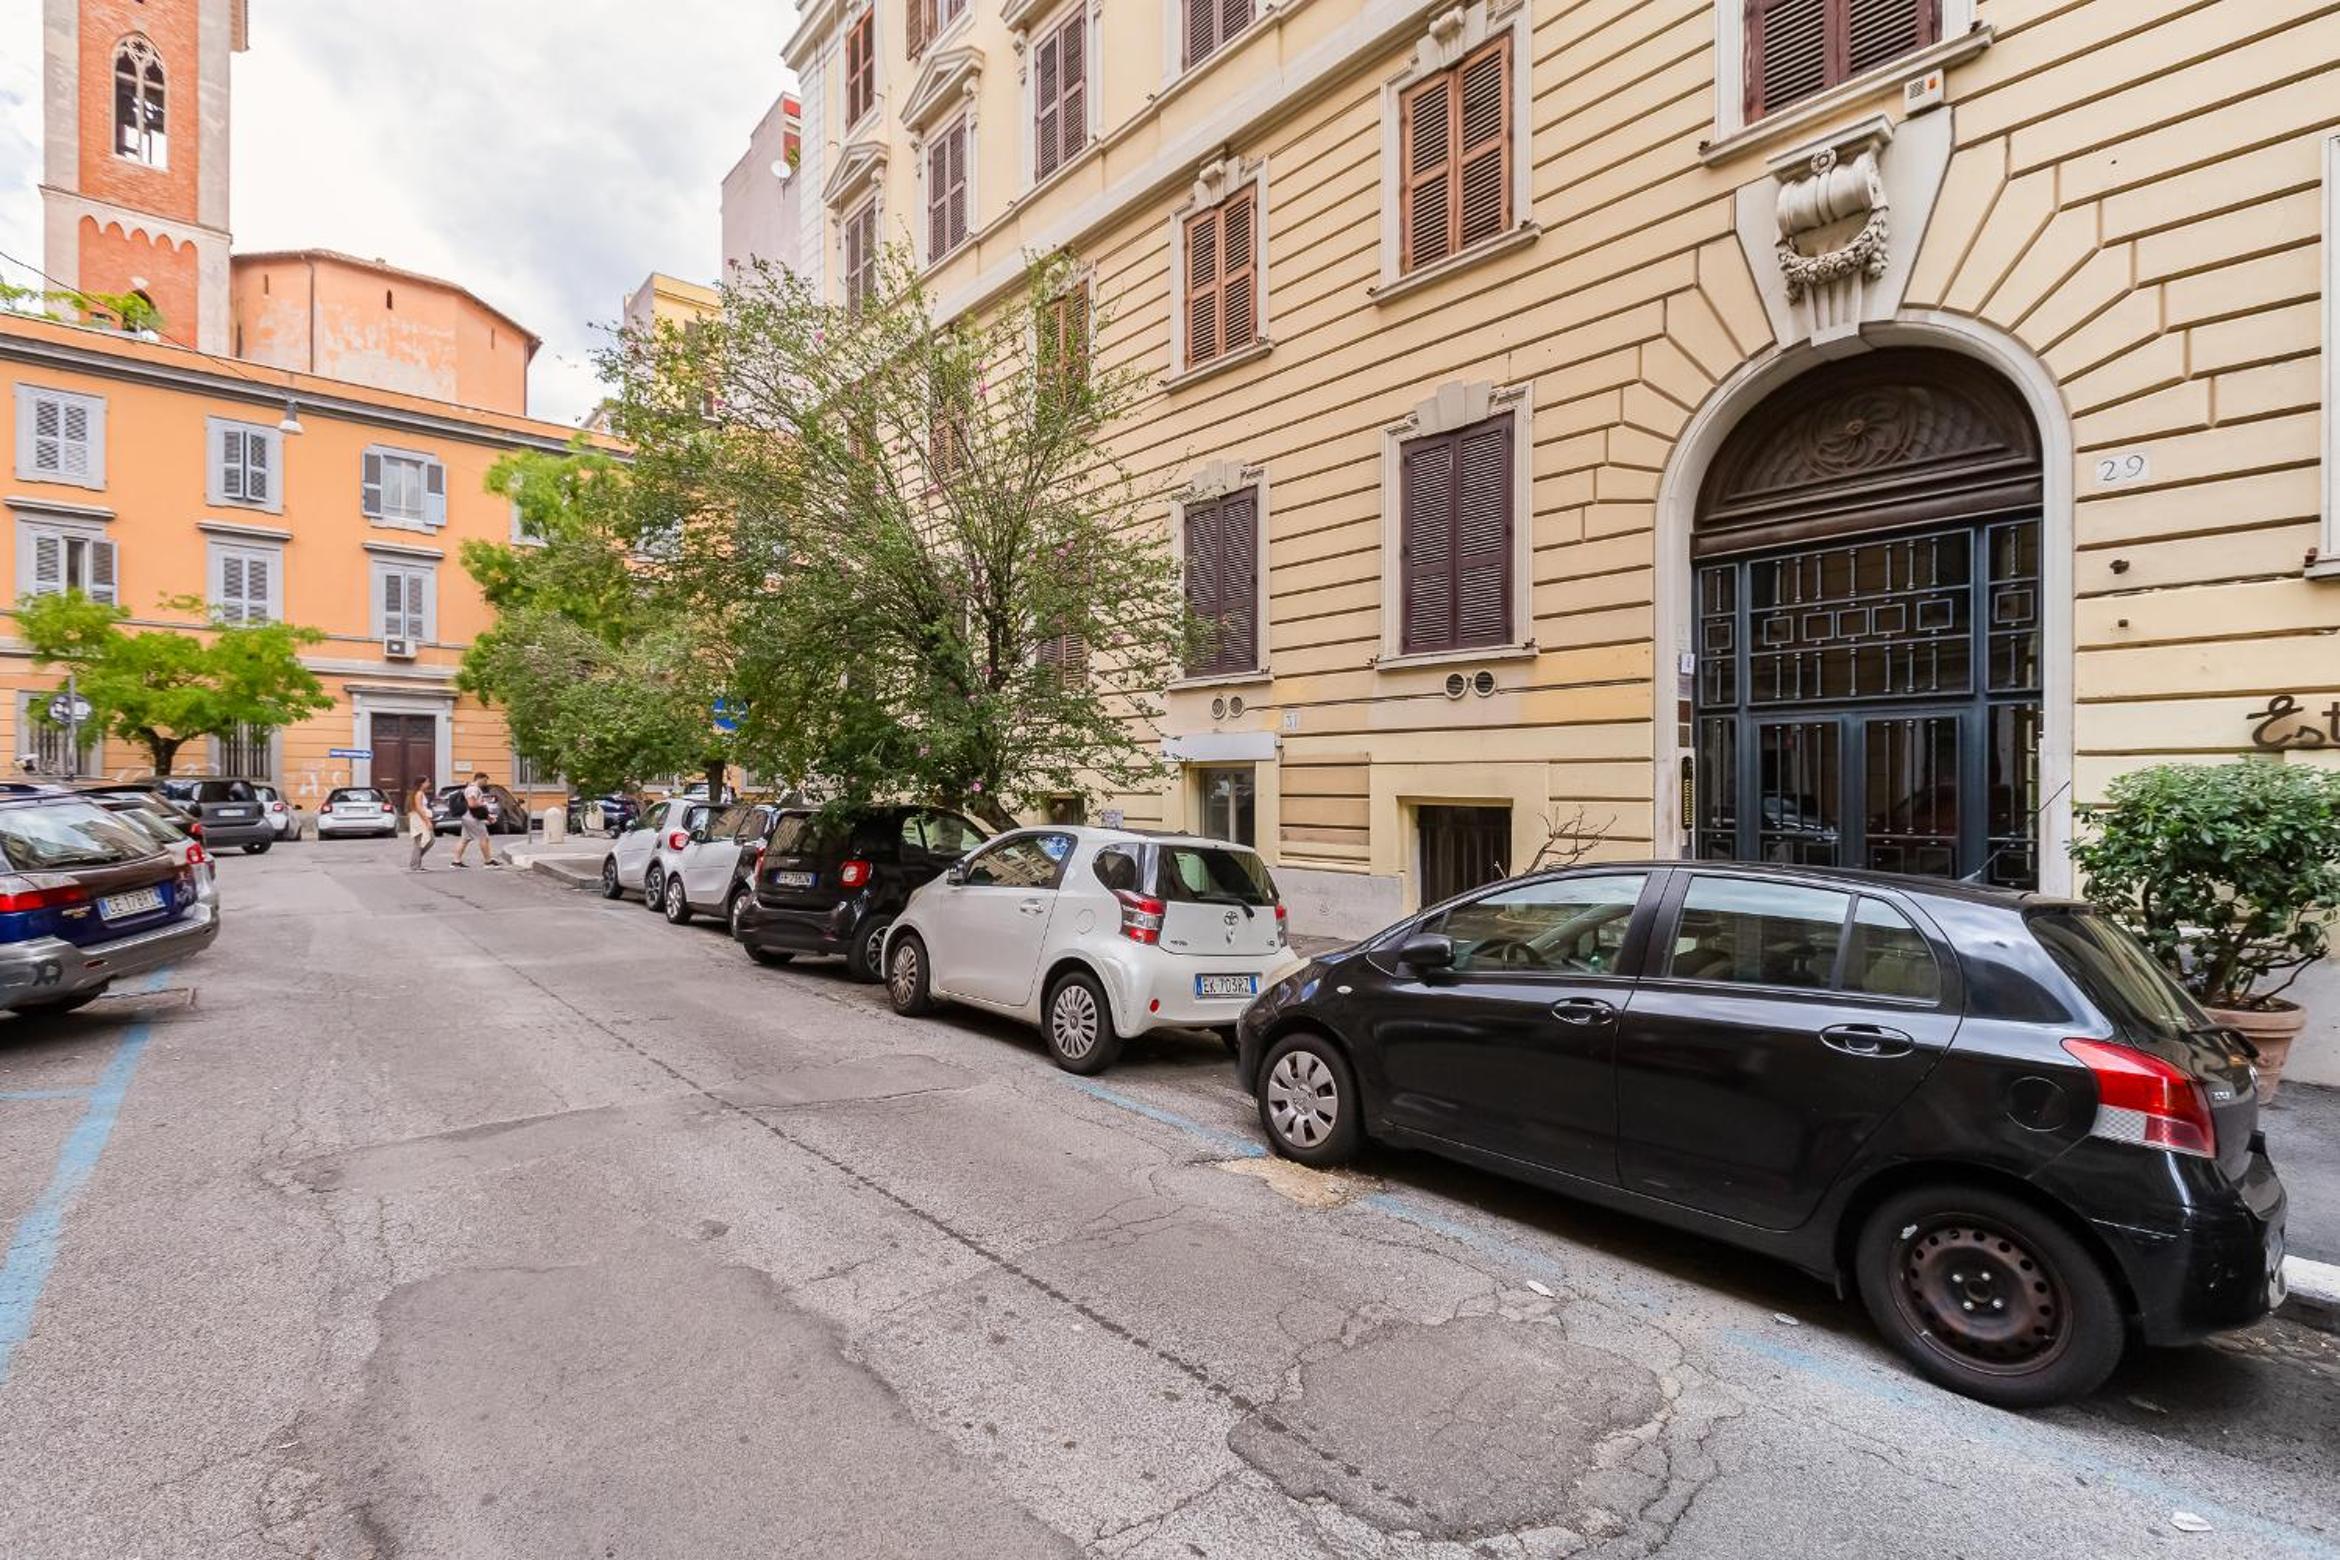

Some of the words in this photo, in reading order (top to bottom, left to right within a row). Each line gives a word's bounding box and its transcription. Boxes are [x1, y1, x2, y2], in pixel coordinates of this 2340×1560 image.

[2101, 454, 2145, 482] 29
[1203, 977, 1215, 993] EK
[1219, 977, 1250, 993] 703RZ
